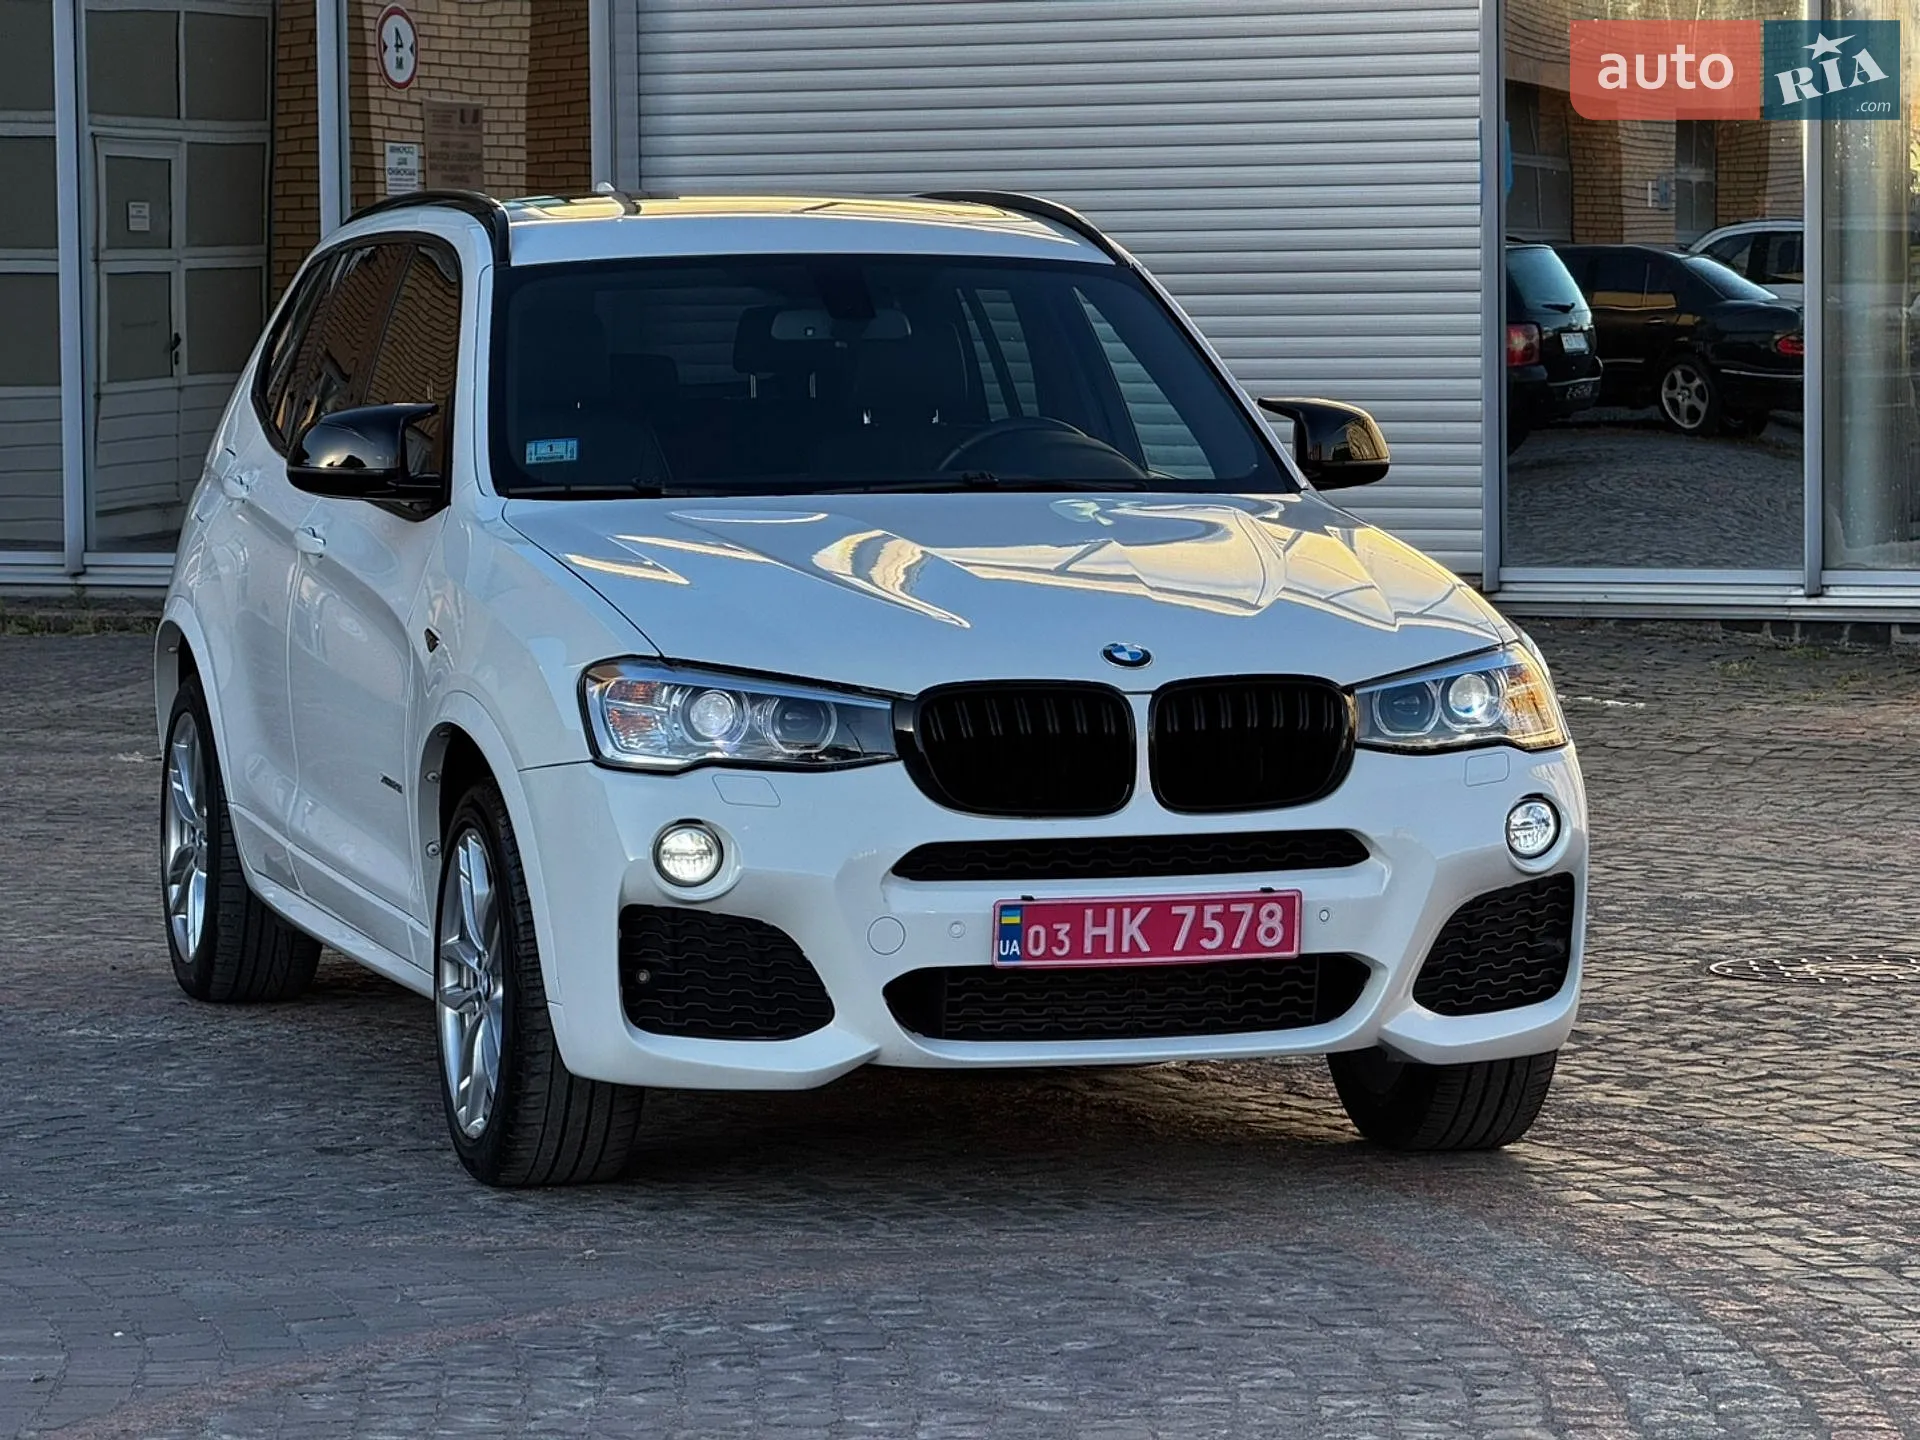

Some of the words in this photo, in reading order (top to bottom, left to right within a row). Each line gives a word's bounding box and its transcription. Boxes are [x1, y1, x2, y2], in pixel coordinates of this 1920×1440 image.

[999, 938, 1020, 956] UA
[1027, 922, 1071, 956] 03
[1083, 906, 1152, 954] HK
[1171, 902, 1284, 952] 7578
